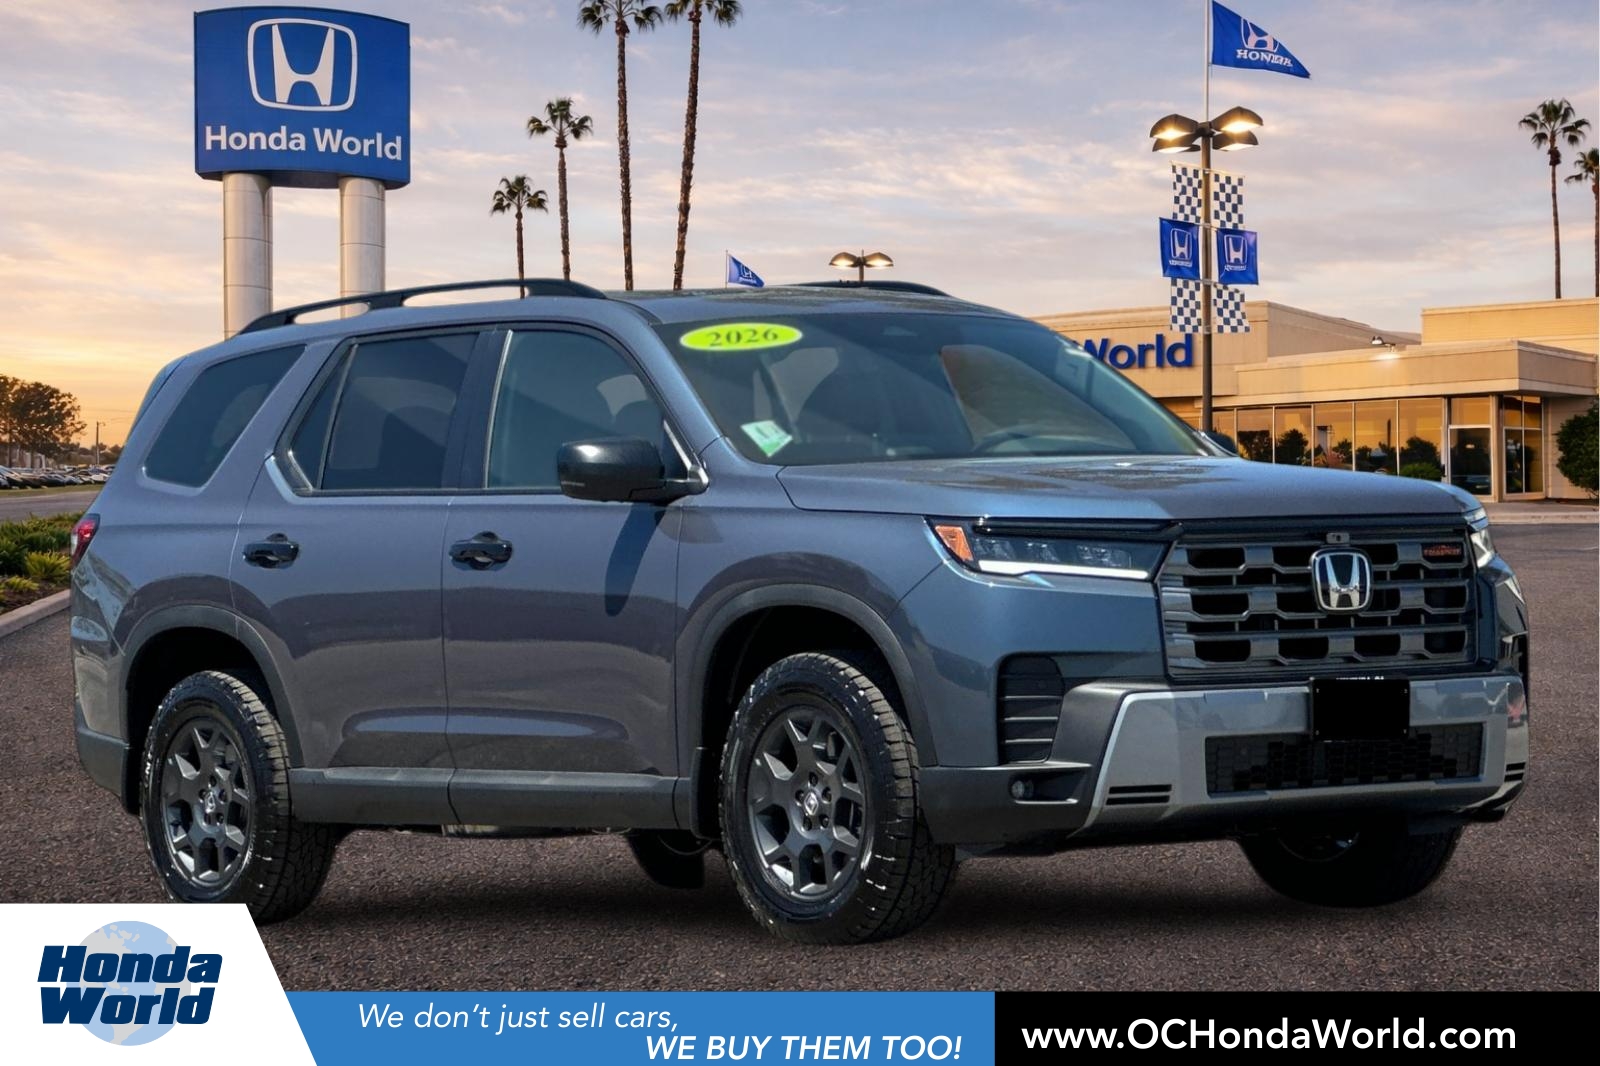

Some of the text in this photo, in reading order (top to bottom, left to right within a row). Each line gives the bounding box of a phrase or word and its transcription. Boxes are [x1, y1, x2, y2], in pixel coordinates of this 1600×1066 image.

[205, 125, 403, 161] Honda World
[707, 328, 778, 347] 2026
